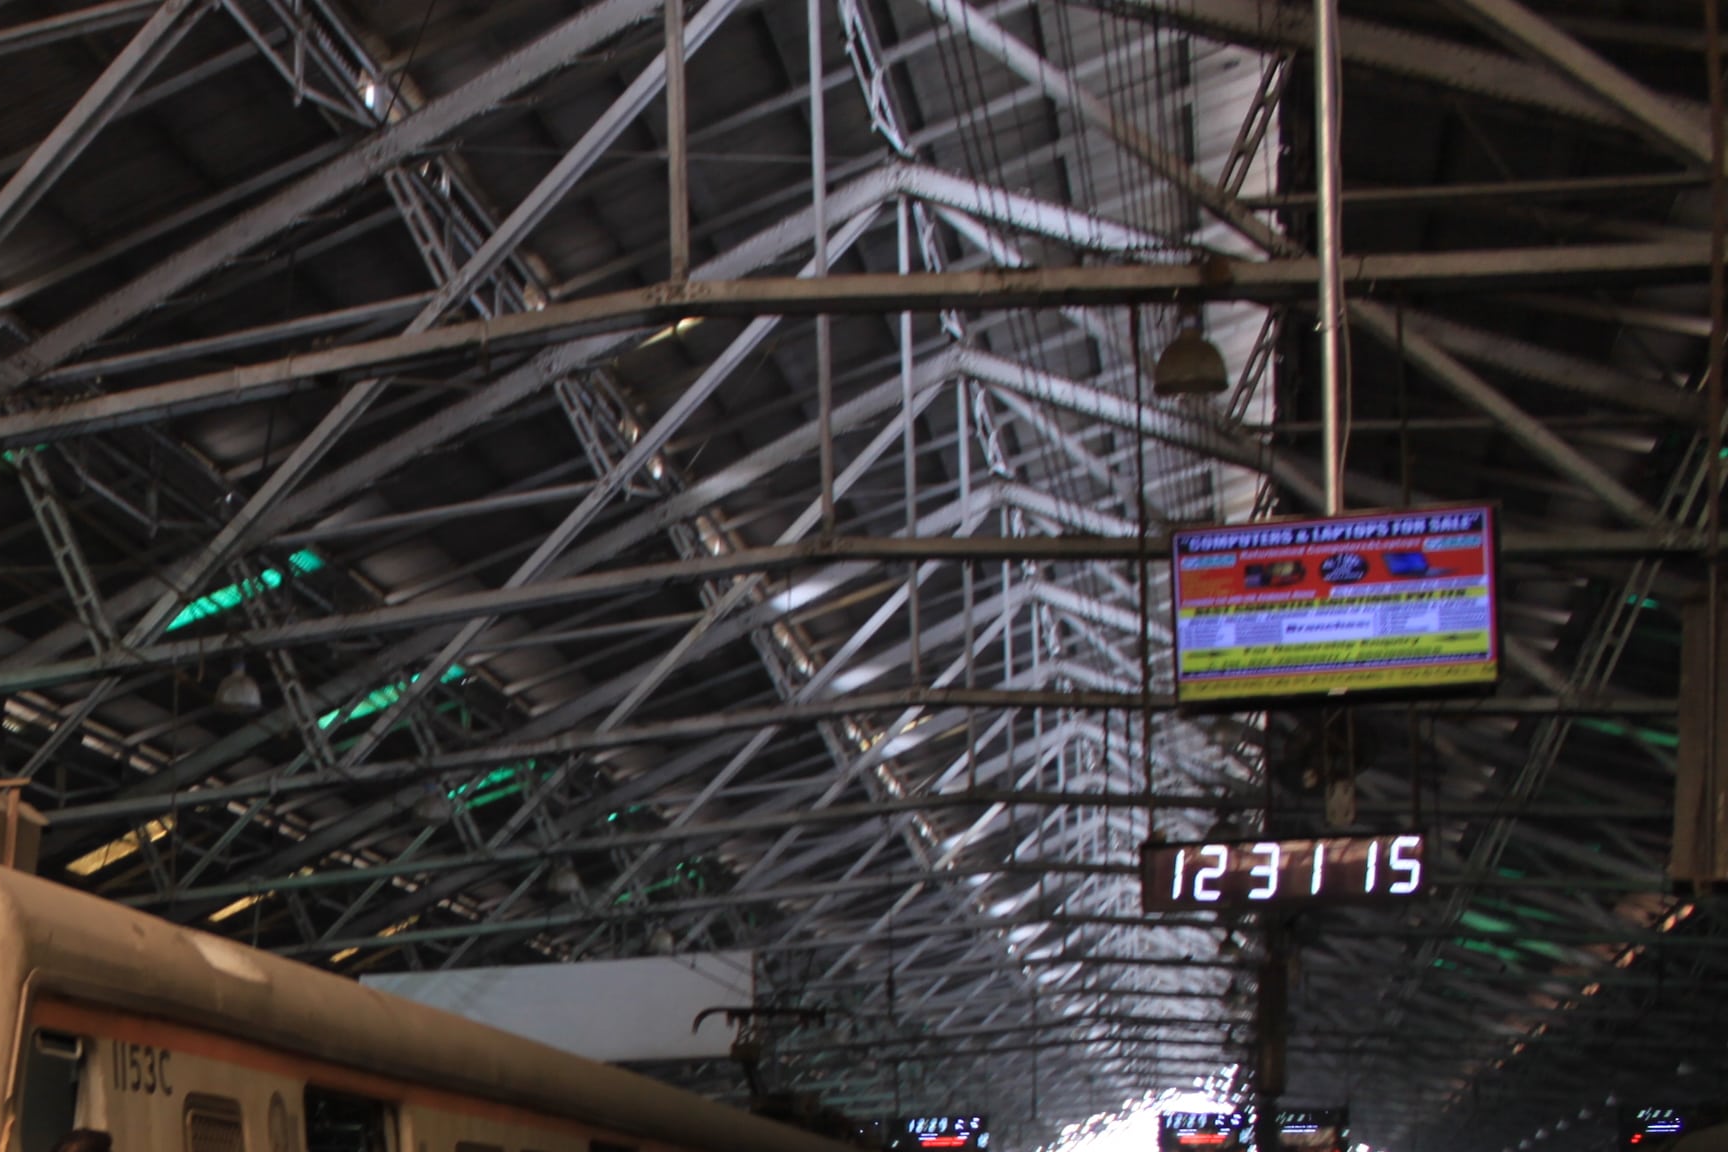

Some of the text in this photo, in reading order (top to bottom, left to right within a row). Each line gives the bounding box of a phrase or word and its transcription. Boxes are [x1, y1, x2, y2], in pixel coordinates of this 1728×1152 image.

[1312, 519, 1389, 542] LAPTOPS
[1391, 516, 1427, 537] FOR
[113, 1038, 173, 1096] 1153C
